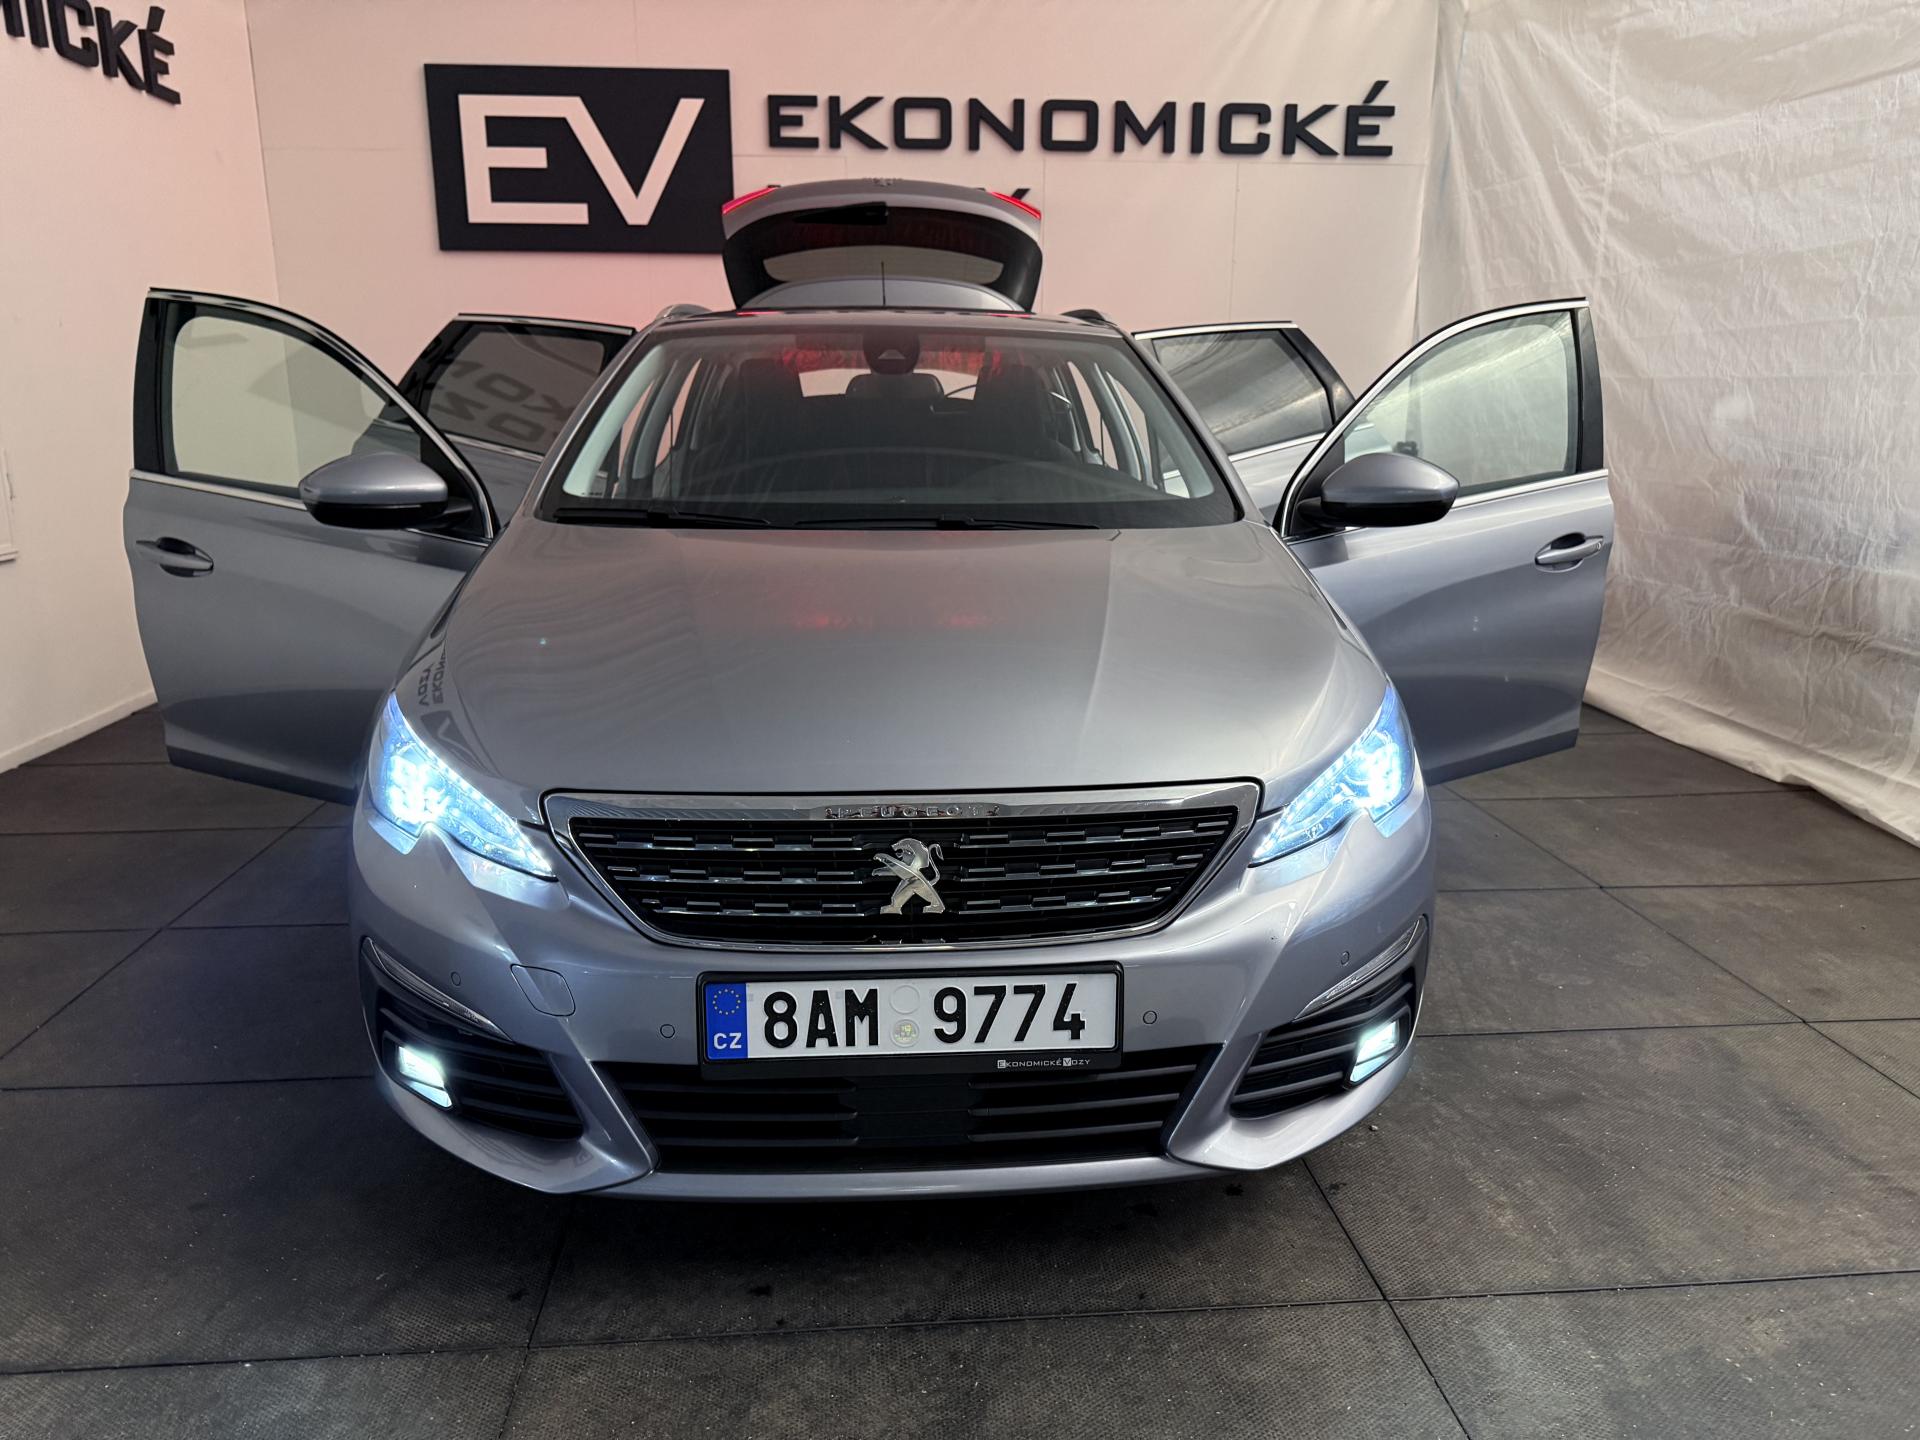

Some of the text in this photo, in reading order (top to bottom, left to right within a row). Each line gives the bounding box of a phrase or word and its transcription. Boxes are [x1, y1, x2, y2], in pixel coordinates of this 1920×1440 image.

[766, 80, 1397, 159] EKONOMICKÉ
[457, 93, 705, 226] EV
[713, 1032, 742, 1050] CZ
[763, 982, 1086, 1049] 8AM 9774
